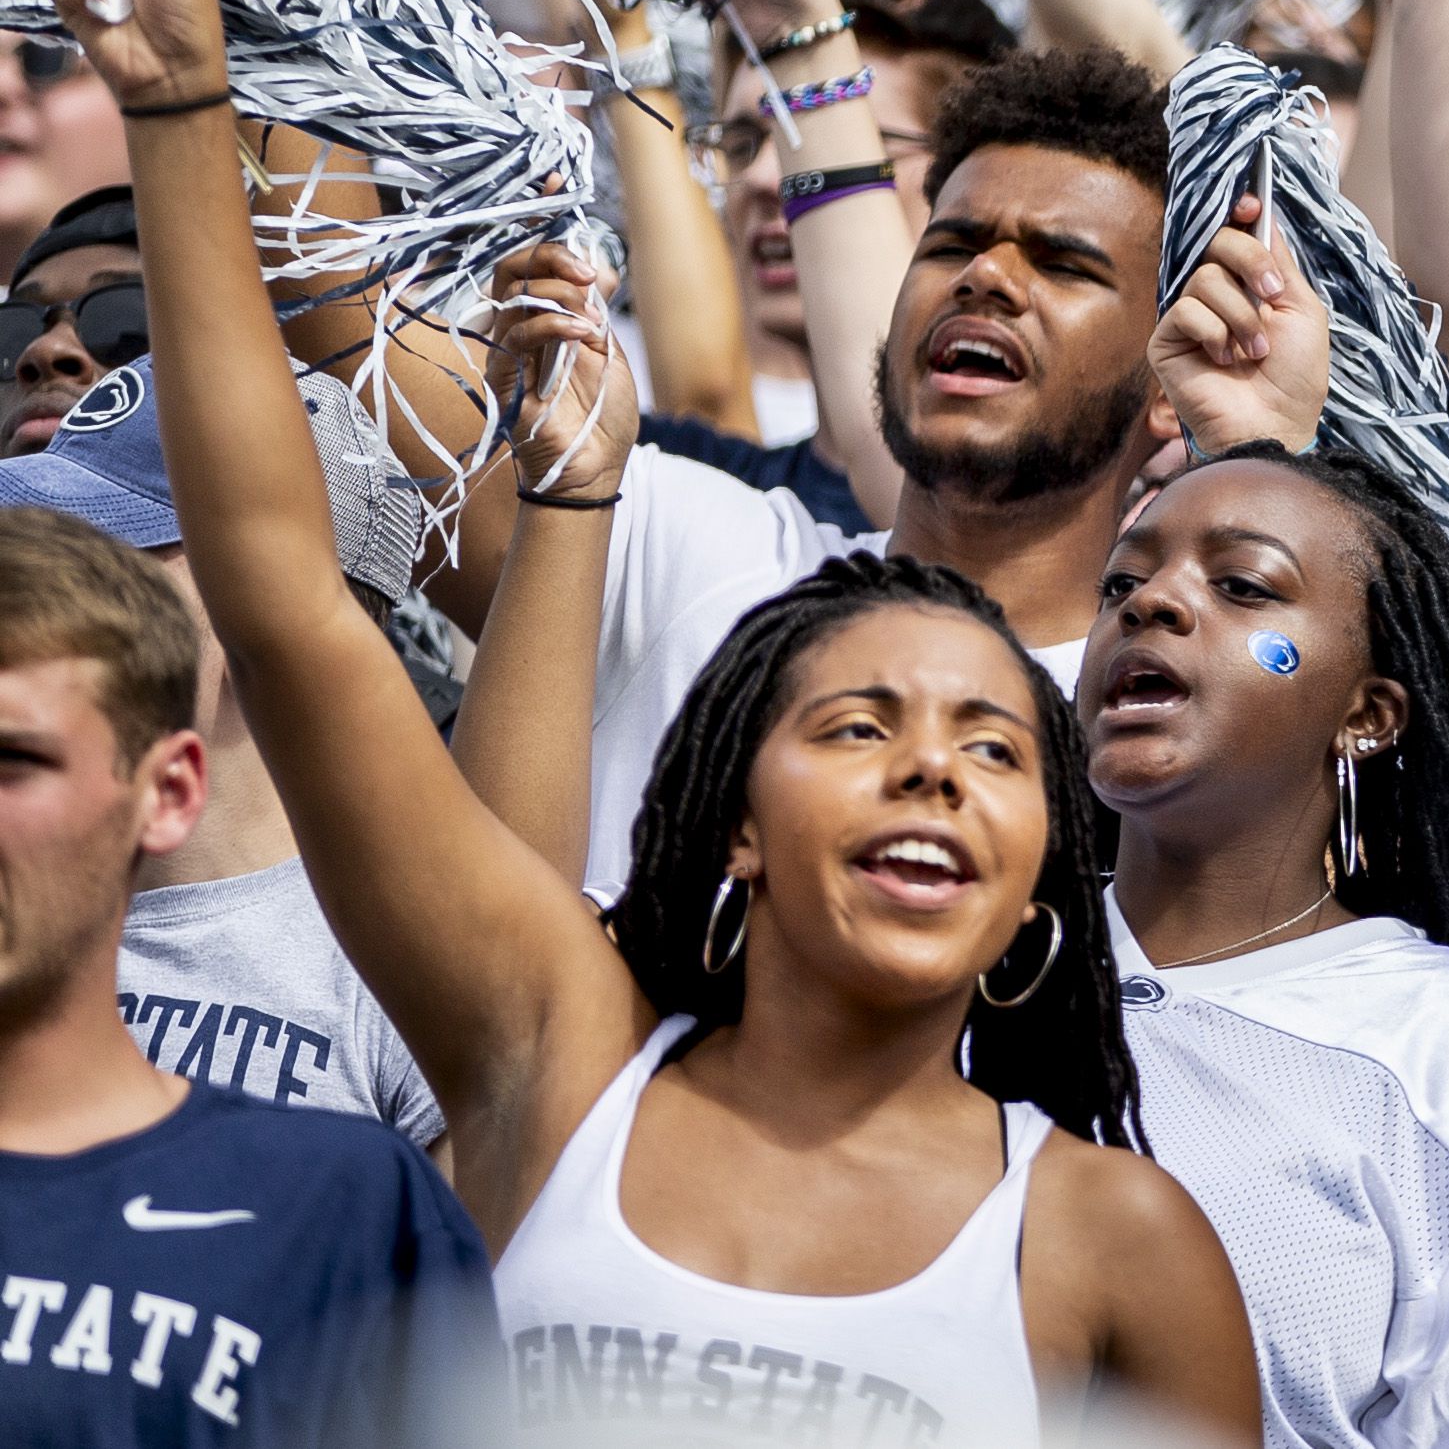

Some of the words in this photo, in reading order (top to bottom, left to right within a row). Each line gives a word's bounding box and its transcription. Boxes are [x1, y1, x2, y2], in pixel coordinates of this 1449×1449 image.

[116, 992, 332, 1106] TATE
[1, 1274, 262, 1426] TATE
[500, 1323, 679, 1429] ENN
